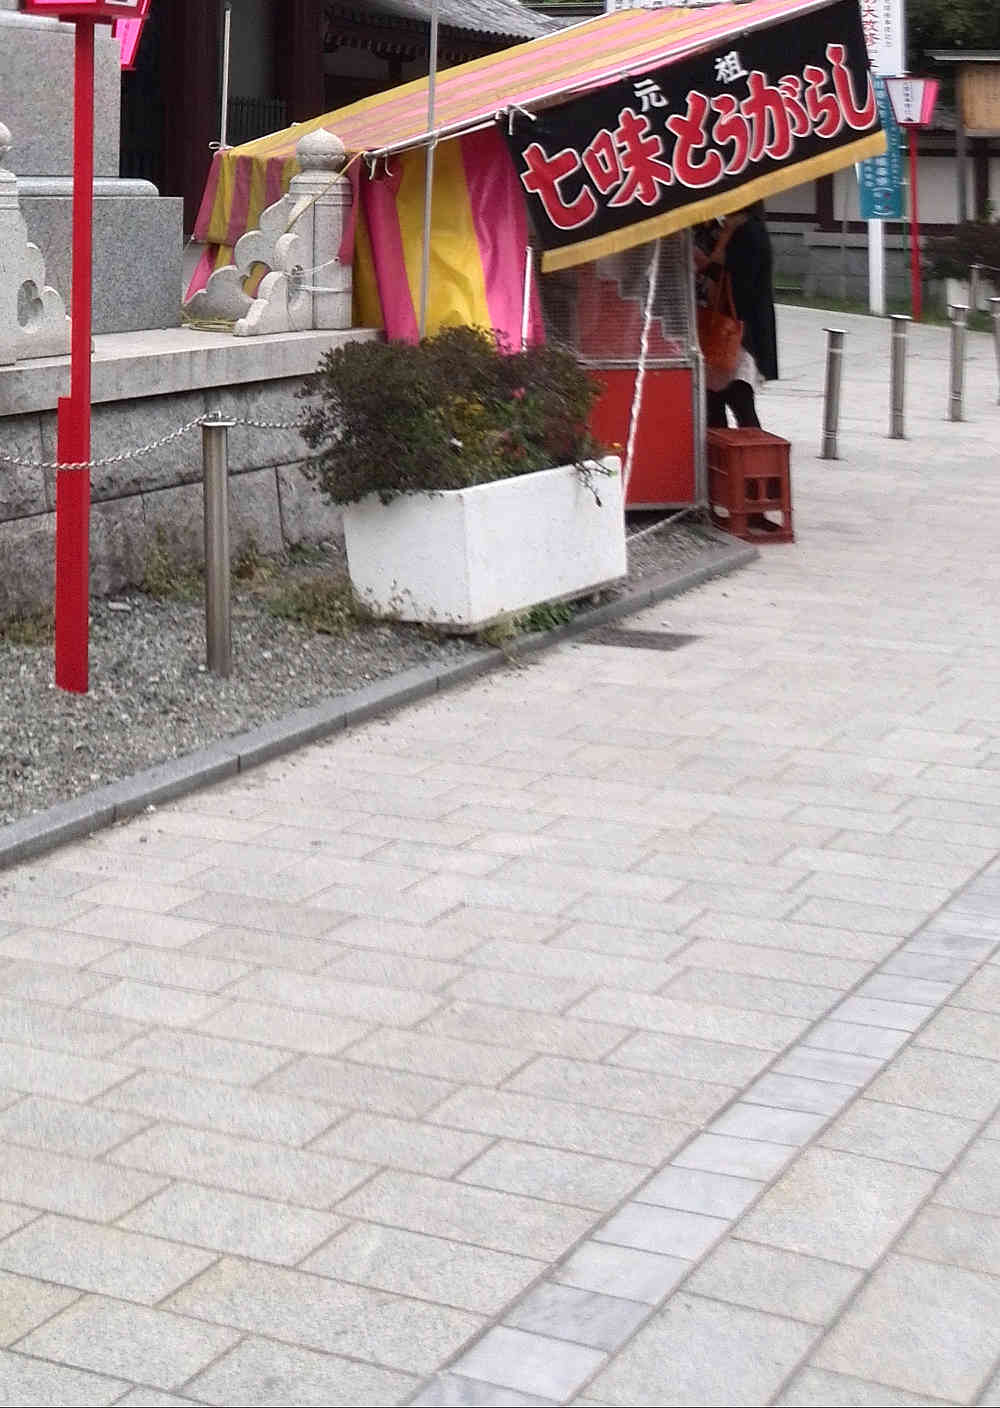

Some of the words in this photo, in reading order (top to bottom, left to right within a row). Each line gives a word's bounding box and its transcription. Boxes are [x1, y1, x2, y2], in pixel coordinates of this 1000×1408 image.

[520, 44, 876, 230] 七味とうがらし
[633, 51, 749, 112] 元祖
